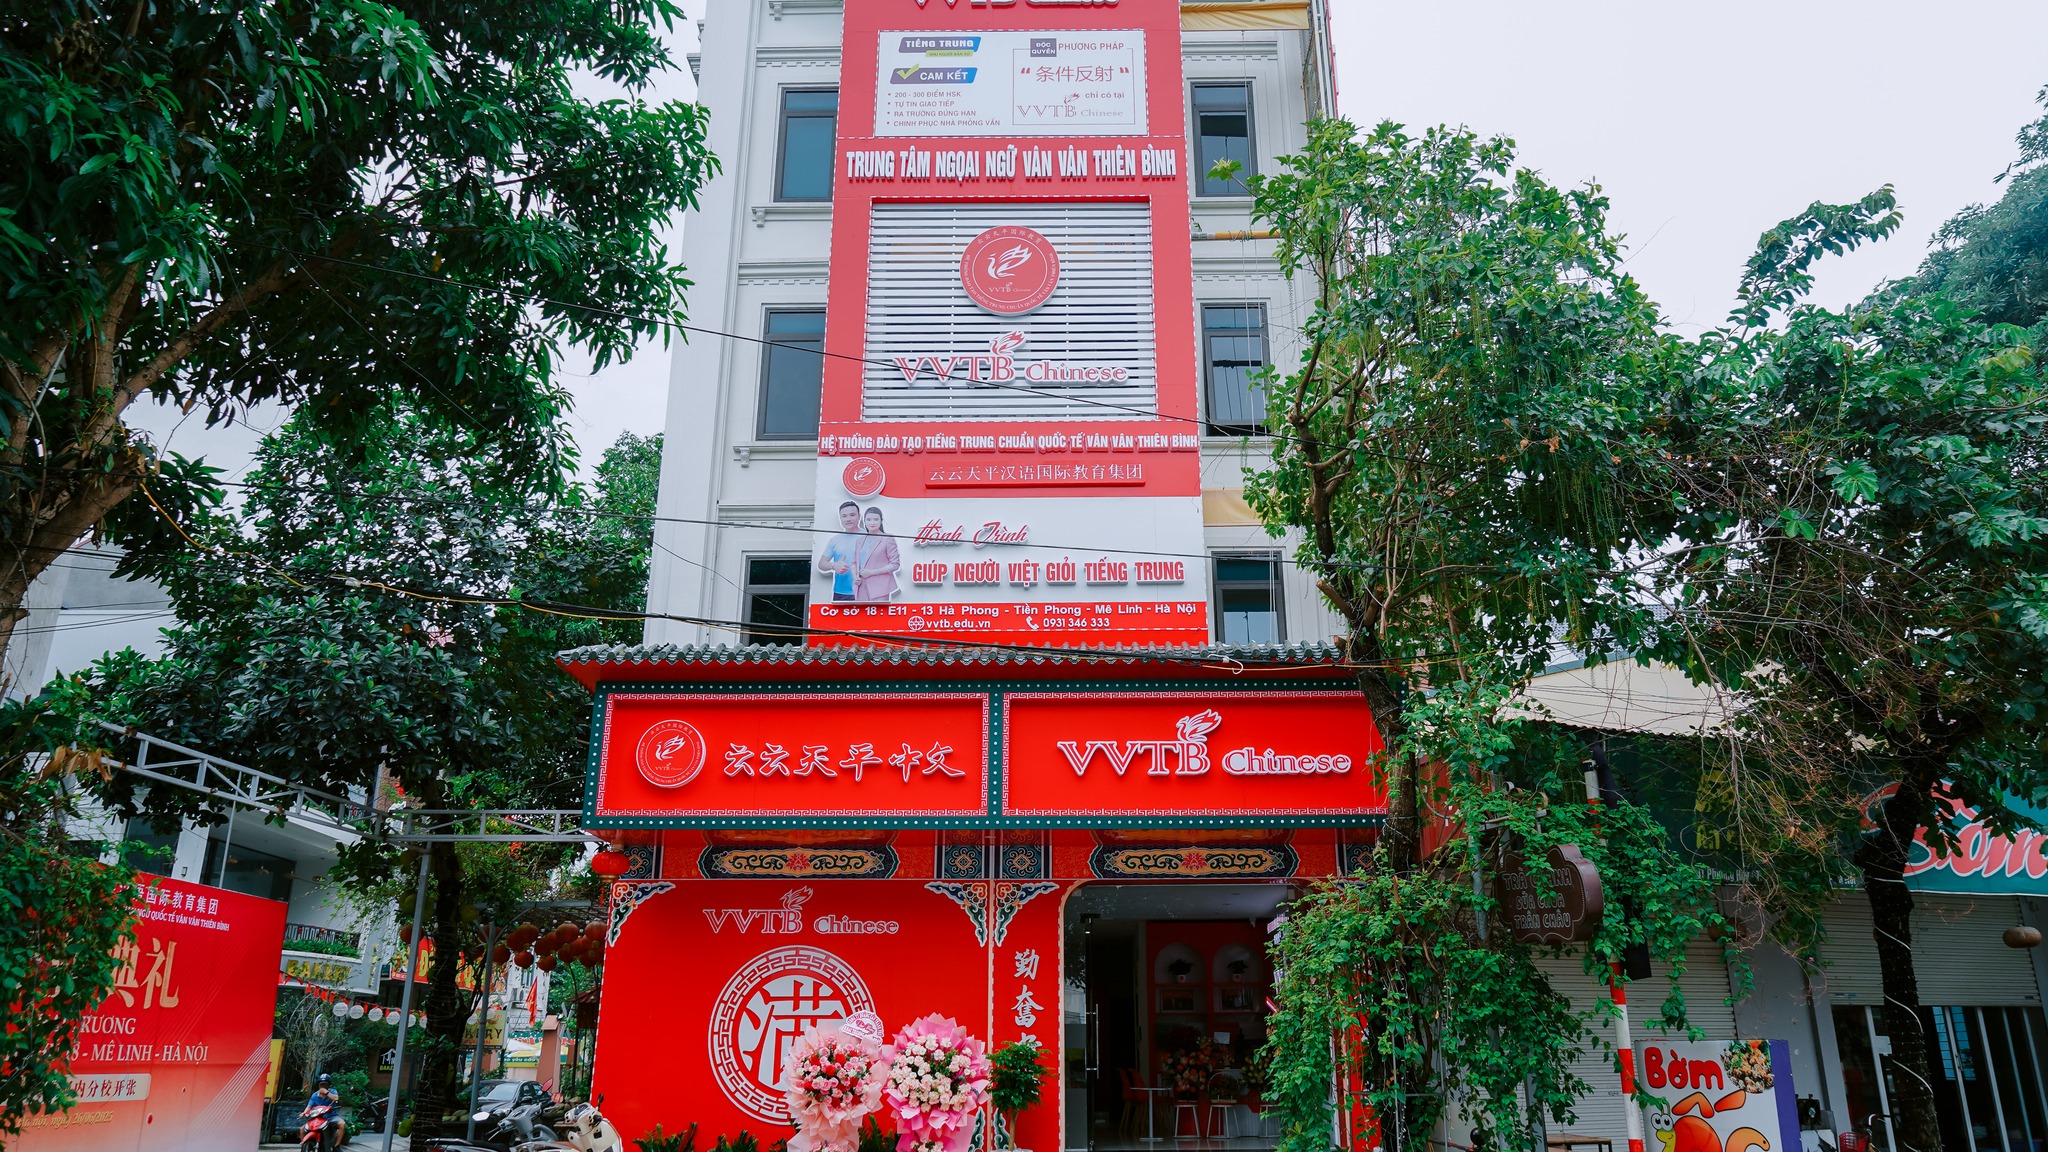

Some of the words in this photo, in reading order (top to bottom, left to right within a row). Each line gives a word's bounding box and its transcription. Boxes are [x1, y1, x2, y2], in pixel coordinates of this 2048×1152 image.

[906, 39, 935, 47] TIẾNG
[1100, 41, 1124, 50] PHÁP
[920, 72, 943, 80] CAM
[947, 69, 968, 80] KẾT
[1036, 66, 1114, 82] 条件反射
[927, 89, 944, 97] ĐIỂM
[1017, 105, 1077, 118] VVTB
[847, 151, 894, 178] TRUNG
[900, 145, 930, 178] TÂM
[936, 151, 979, 181] NGOẠI
[986, 144, 1017, 178] NGỮ
[1023, 145, 1052, 177] VÂN
[1058, 145, 1087, 177] VÂN
[1093, 144, 1135, 176] THIÊN
[1142, 144, 1176, 175] BÌNH
[894, 355, 1015, 384] VVTB
[1025, 360, 1128, 382] Chinese
[821, 434, 835, 452] HỆ
[838, 432, 872, 449] THỐNG
[876, 435, 898, 449] ĐÀO
[902, 436, 922, 452] TẠO
[926, 432, 956, 449] TIẾNG
[960, 436, 994, 448] TRUNG
[999, 432, 1035, 448] CHUẨN
[1039, 432, 1067, 449] QUỐC
[1070, 432, 1085, 448] TẾ
[1087, 433, 1108, 448] VÂN
[1112, 433, 1133, 448] VÂN
[1138, 433, 1168, 447] THIÊN
[1172, 432, 1197, 447] BÌNH
[930, 463, 1142, 482] 云云天平汉语国际教育集团
[914, 519, 963, 543] Hành
[913, 560, 947, 582] GIÚP
[954, 559, 1000, 582] NGƯỜI
[1008, 559, 1039, 585] VIỆT
[1046, 557, 1076, 581] GIỎI
[1085, 556, 1128, 581] TIẾNG
[1135, 562, 1184, 580] TRUNG
[820, 606, 838, 616] Cơ
[843, 607, 859, 615] sở
[865, 607, 877, 615] 18
[888, 606, 907, 615] E11
[921, 606, 933, 615] 13
[939, 605, 954, 615] Hà
[962, 606, 998, 617] Phong
[1014, 604, 1038, 615] Tiền
[1044, 606, 1082, 616] Phong
[1095, 605, 1112, 614] Mê
[1118, 605, 1142, 614] Linh
[1155, 604, 1170, 614] Hà
[1177, 604, 1196, 616] Nội
[926, 619, 991, 628] vvtb.edu.vn
[1043, 618, 1066, 628] 0931
[1068, 618, 1087, 627] 346
[1090, 618, 1110, 627] 333
[724, 740, 965, 782] 云云天平中文
[1057, 740, 1211, 776] VVTB
[1222, 747, 1351, 775] Chinese
[1502, 867, 1527, 890] TRÀ
[703, 908, 803, 934] VVTB
[813, 914, 899, 935] Chinese
[1514, 910, 1540, 929] TRÂN
[1543, 909, 1571, 928] CHÂU
[72, 1015, 136, 1034] RƯƠNG
[90, 1040, 115, 1061] MÊ
[117, 1044, 153, 1061] LINH
[162, 1042, 181, 1061] HÀ
[184, 1042, 208, 1065] NỘI
[1644, 1046, 1724, 1090] Bờm
